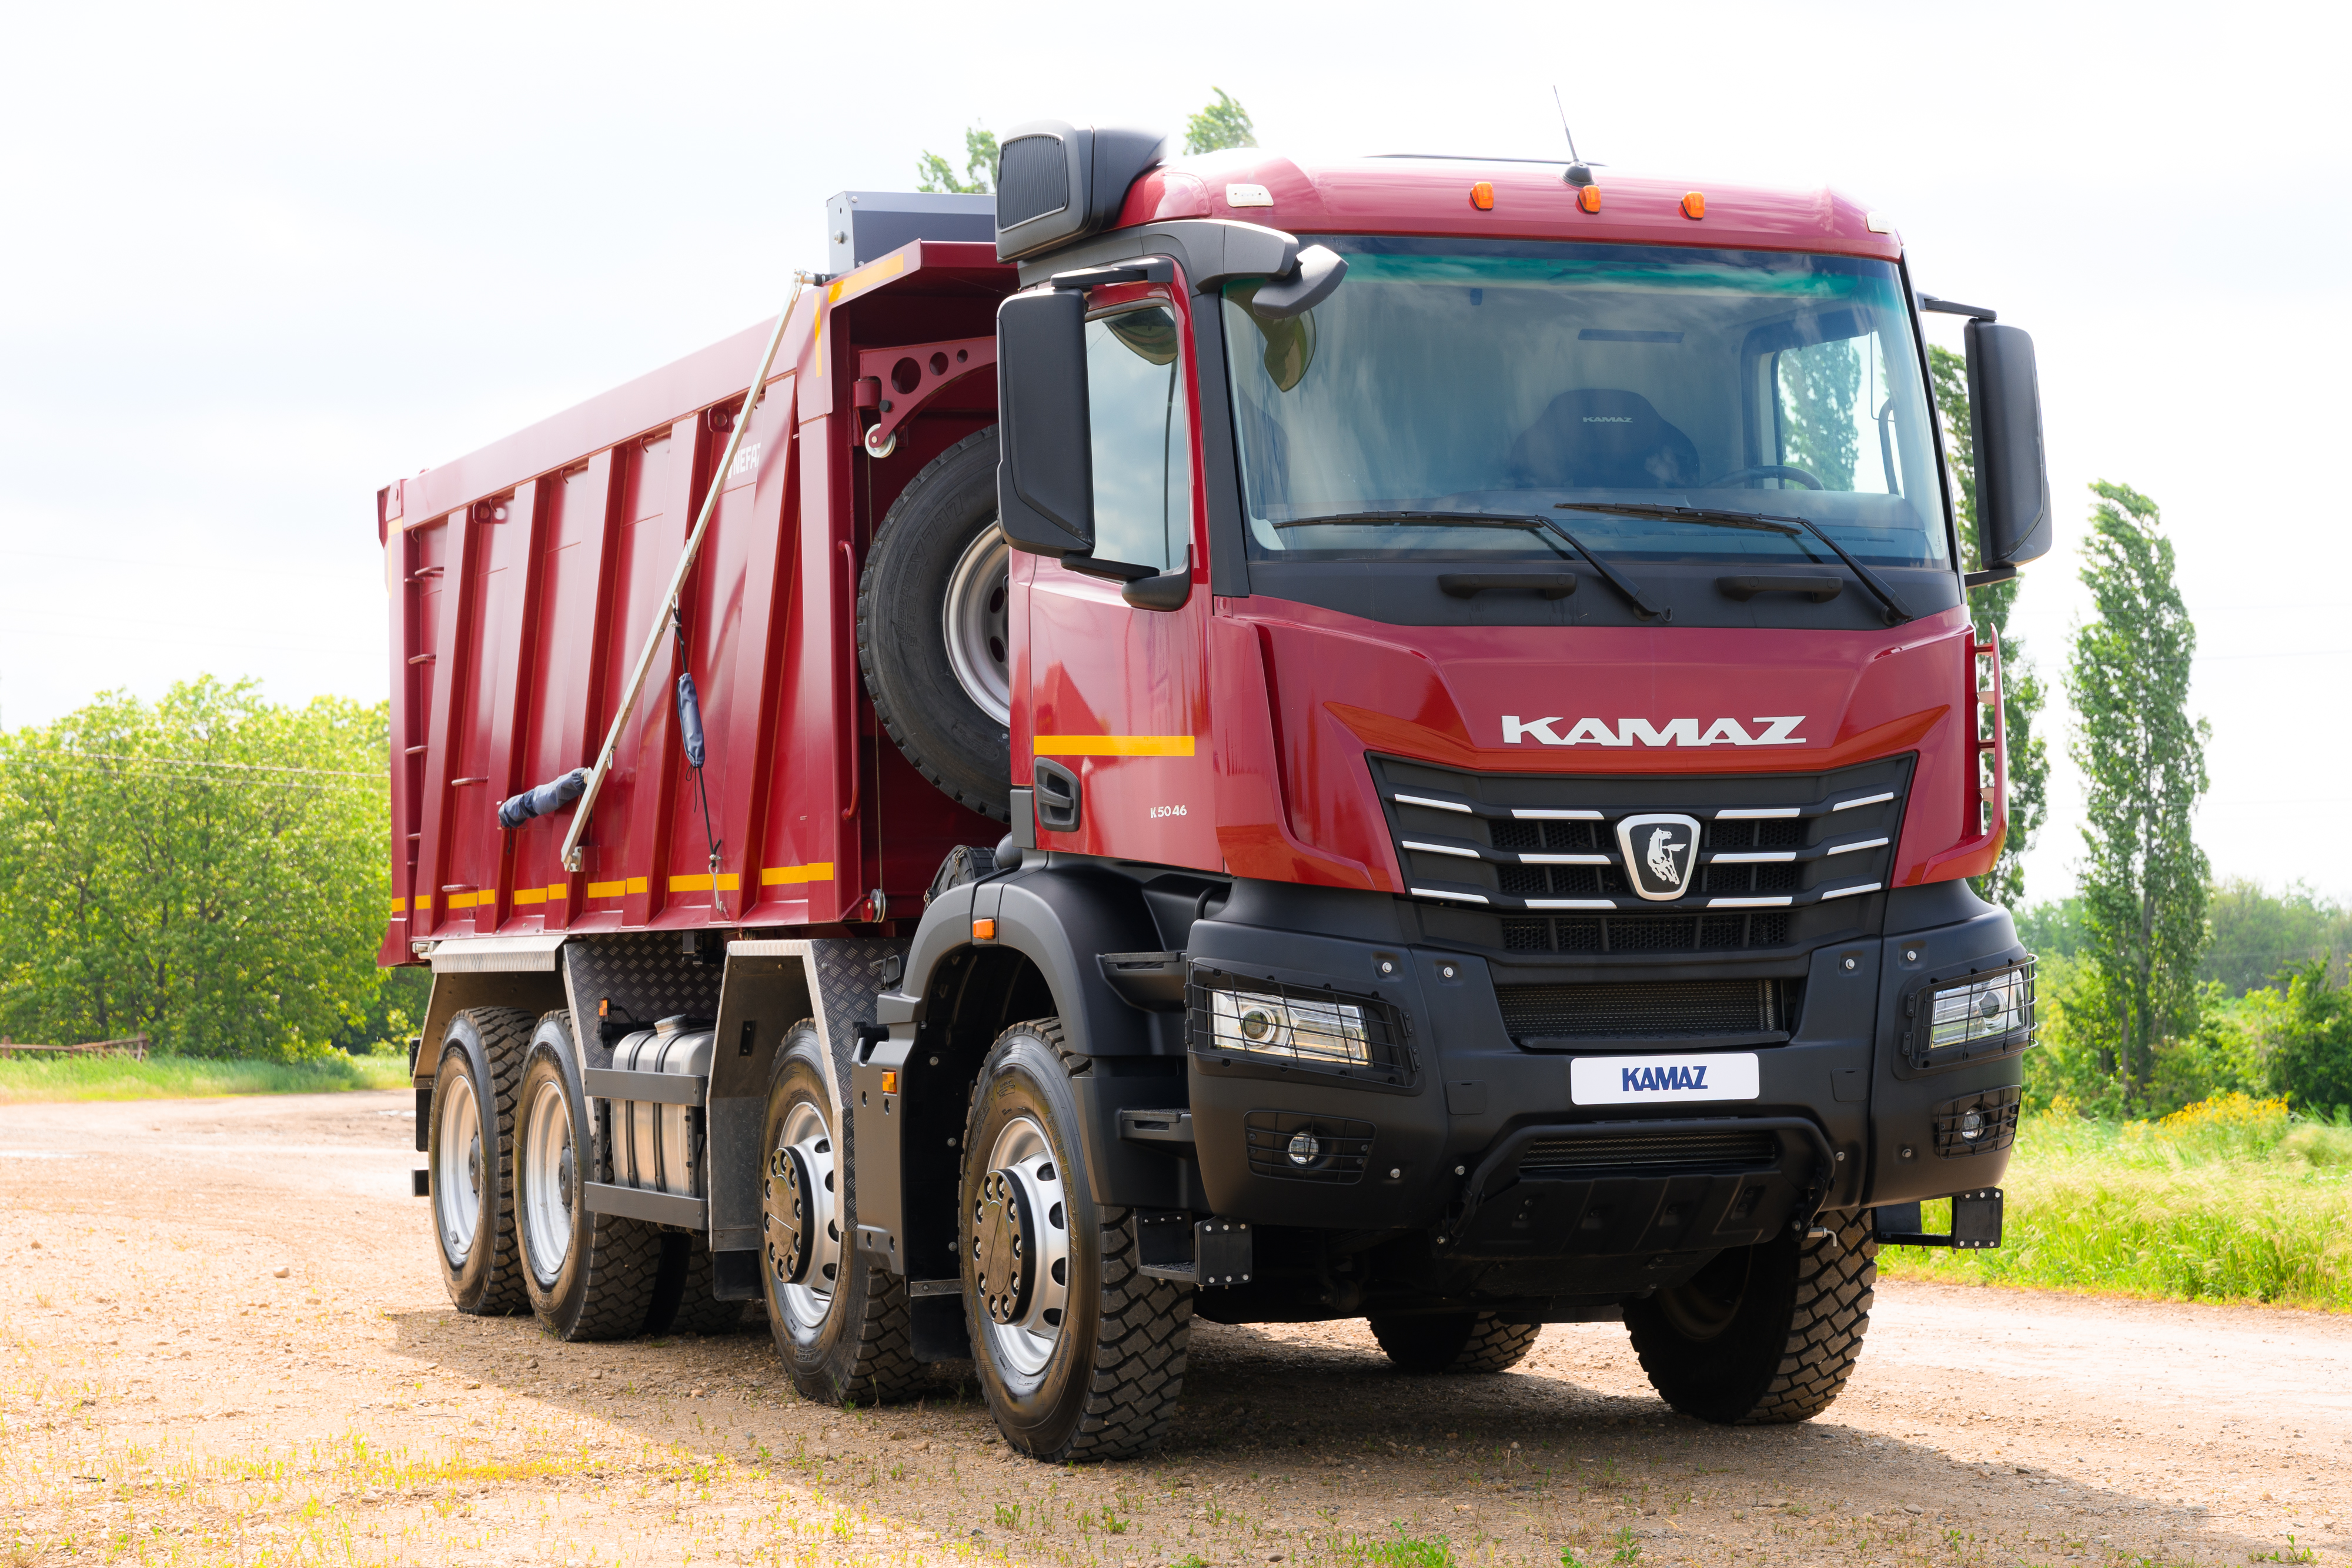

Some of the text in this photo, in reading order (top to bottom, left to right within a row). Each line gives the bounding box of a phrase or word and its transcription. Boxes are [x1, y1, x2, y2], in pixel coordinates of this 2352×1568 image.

[897, 583, 910, 644] SUPER
[907, 591, 919, 647] STEEL
[1501, 715, 1806, 747] KAMAZ
[1622, 1065, 1708, 1092] KAMAZ
